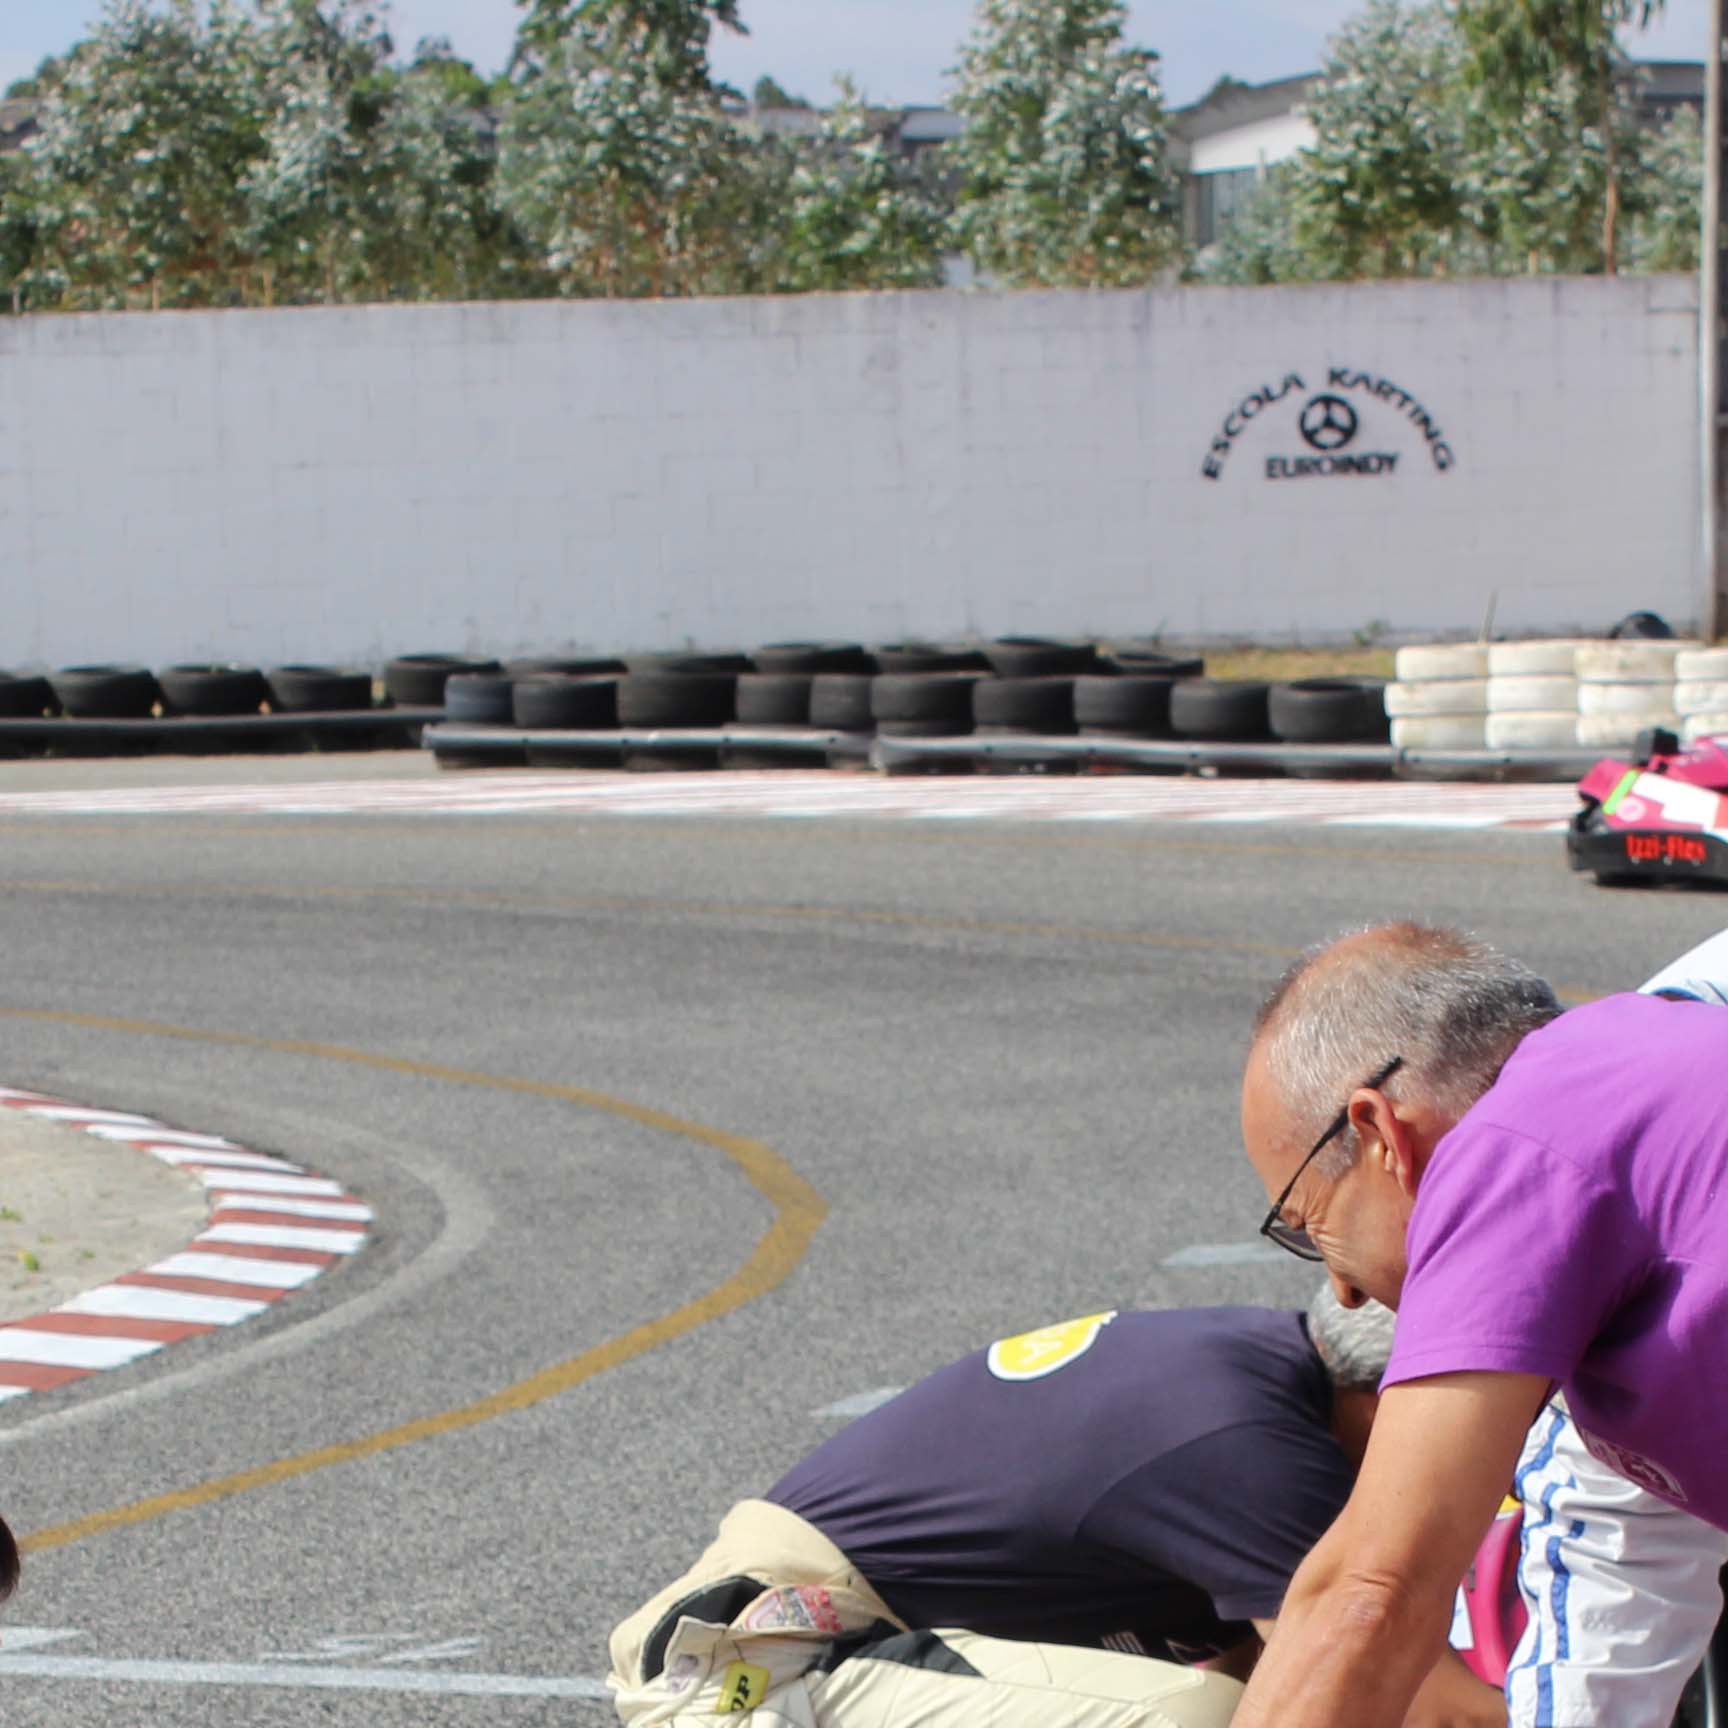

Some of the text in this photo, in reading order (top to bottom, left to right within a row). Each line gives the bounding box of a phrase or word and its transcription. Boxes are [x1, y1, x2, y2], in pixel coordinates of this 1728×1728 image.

[1200, 366, 1461, 481] ESCOLA KARTING
[1264, 450, 1400, 480] EUROINDY
